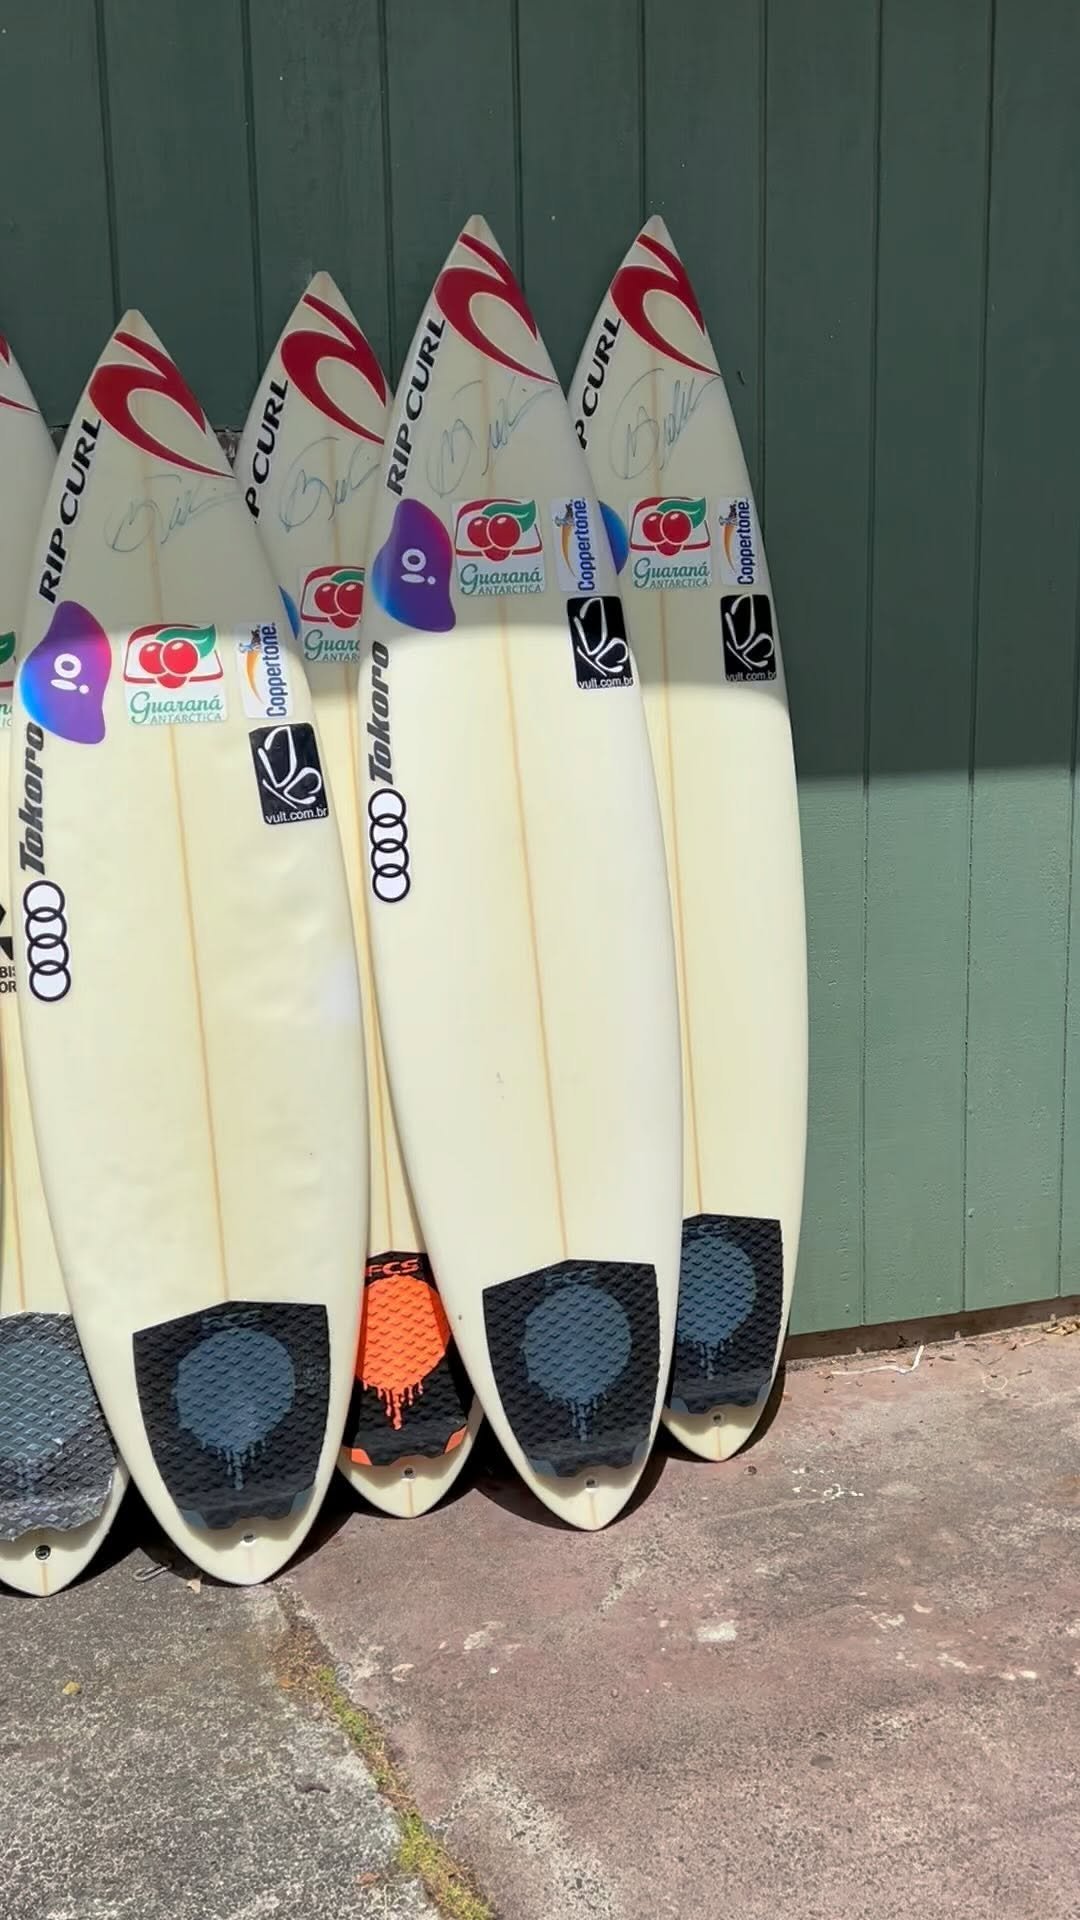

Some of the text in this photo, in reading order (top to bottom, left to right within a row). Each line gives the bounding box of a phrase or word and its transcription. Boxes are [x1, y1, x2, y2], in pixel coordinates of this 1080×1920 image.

[582, 318, 622, 417] CURL
[252, 380, 288, 484] CURL
[386, 318, 446, 496] RIP CURL
[38, 418, 102, 604] RIP CURL
[572, 499, 597, 592] Coppertone
[736, 499, 755, 585] Coppertone
[460, 563, 543, 595] Guaraná
[477, 584, 542, 595] ANTARCTICA
[633, 557, 710, 589] Guaraná
[650, 579, 709, 589] ANTARCTICA
[262, 624, 289, 718] Coppertone
[578, 676, 634, 689] vult.com.br
[129, 691, 223, 725] Guaraná
[150, 712, 222, 725] ANTARCTICA
[366, 641, 394, 785] Tokoro
[18, 721, 45, 876] Tokoro
[265, 807, 328, 824] vult.com.br
[367, 1258, 420, 1277] FCS
